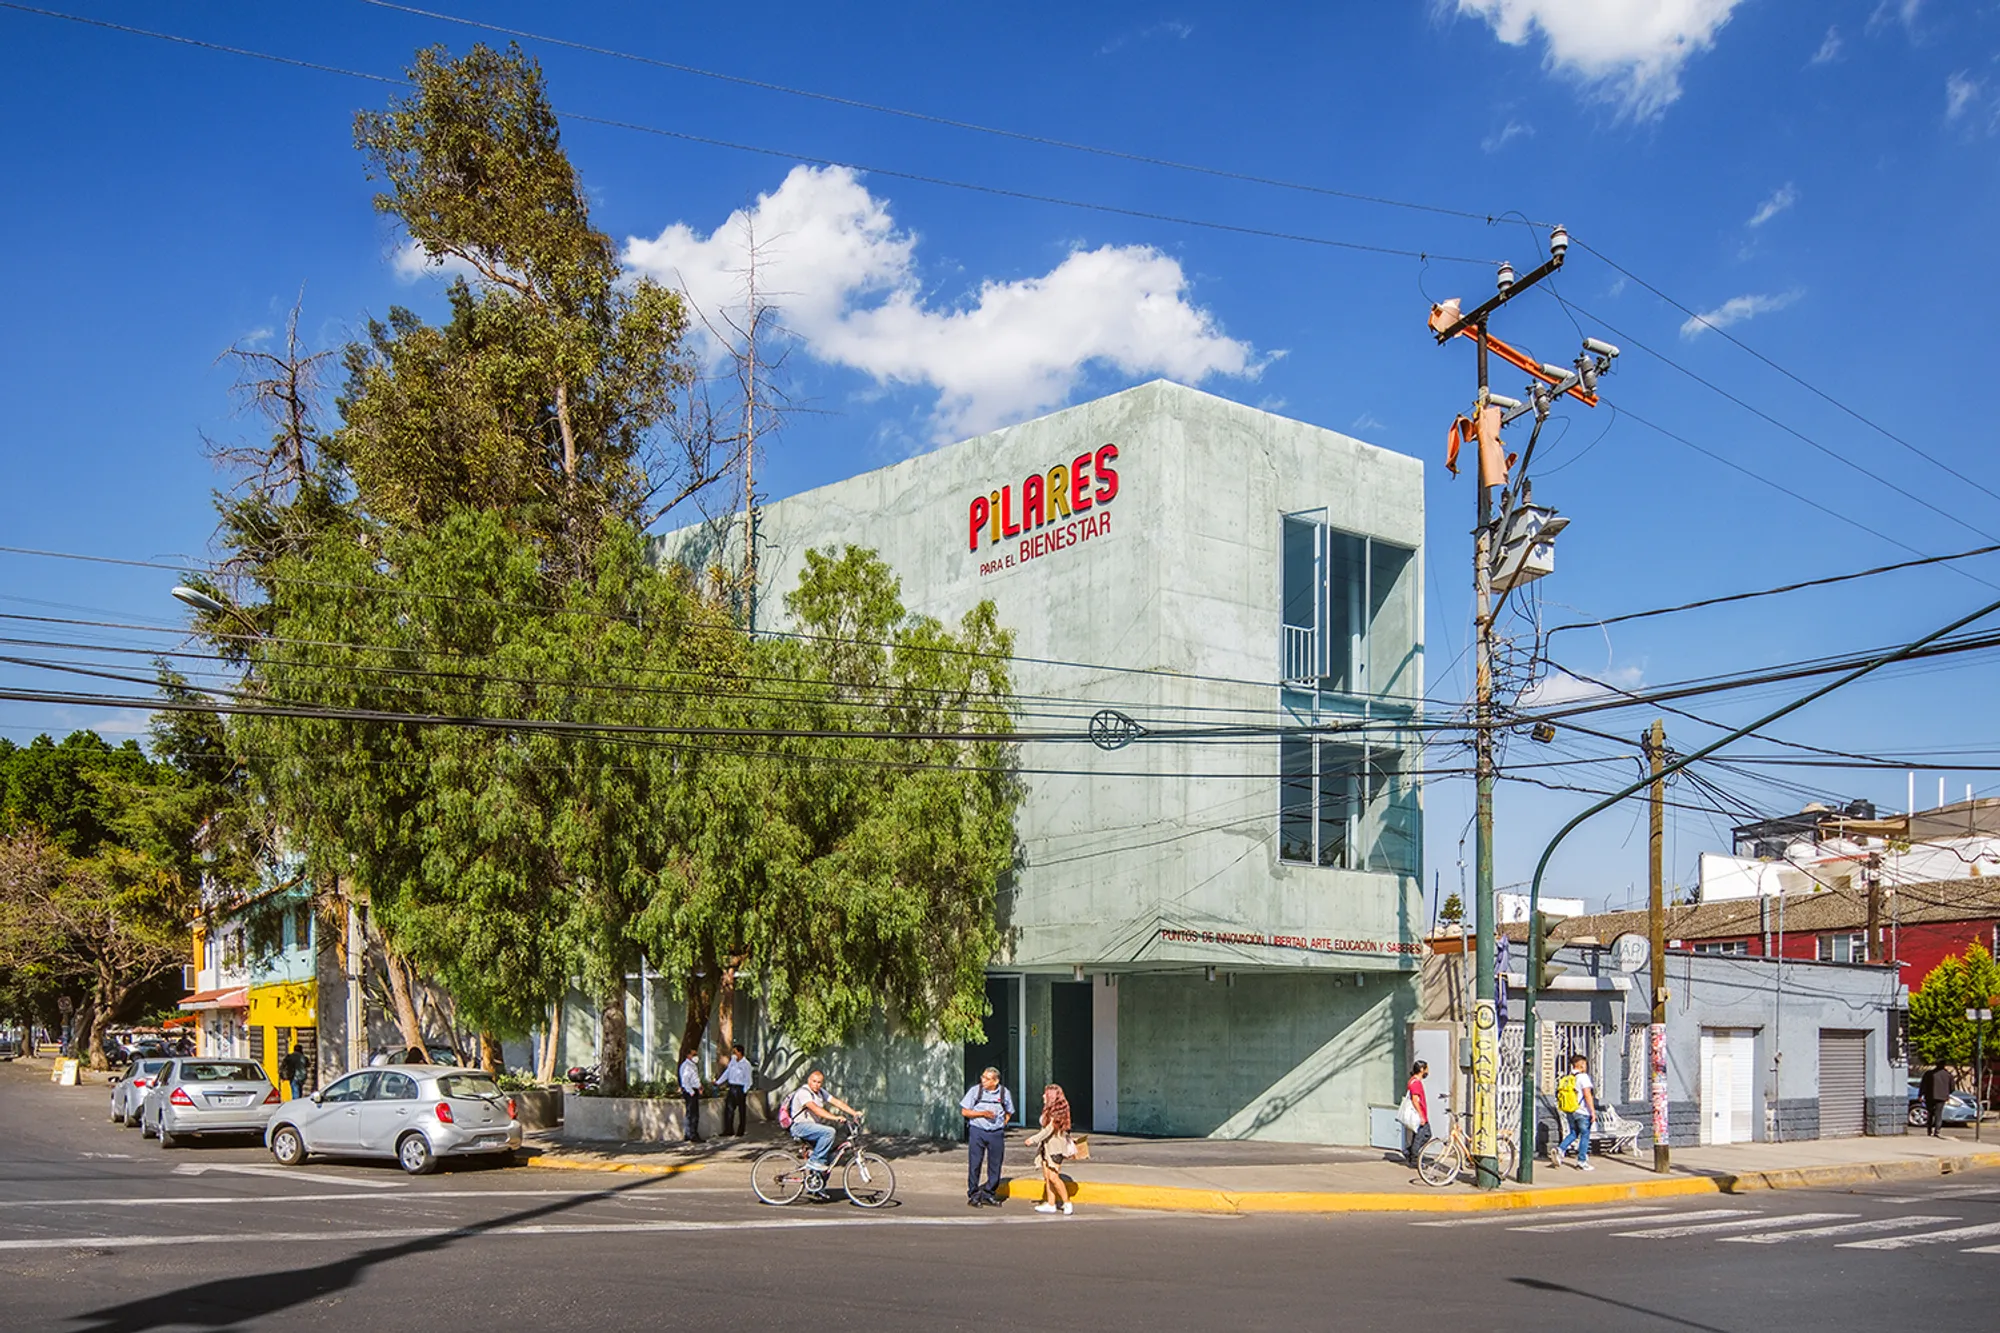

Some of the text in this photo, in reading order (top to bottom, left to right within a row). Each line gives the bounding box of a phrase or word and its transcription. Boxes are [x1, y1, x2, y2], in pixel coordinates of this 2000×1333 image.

[980, 511, 1111, 577] PARA EL BIENESTAR
[1162, 929, 1198, 943] PUNTOS
[1202, 932, 1213, 943] DE
[1335, 939, 1377, 952] EDUCACIÓN
[1379, 942, 1384, 952] Y
[1386, 942, 1421, 955] SABERES
[1475, 1040, 1491, 1152] CARNITAS
